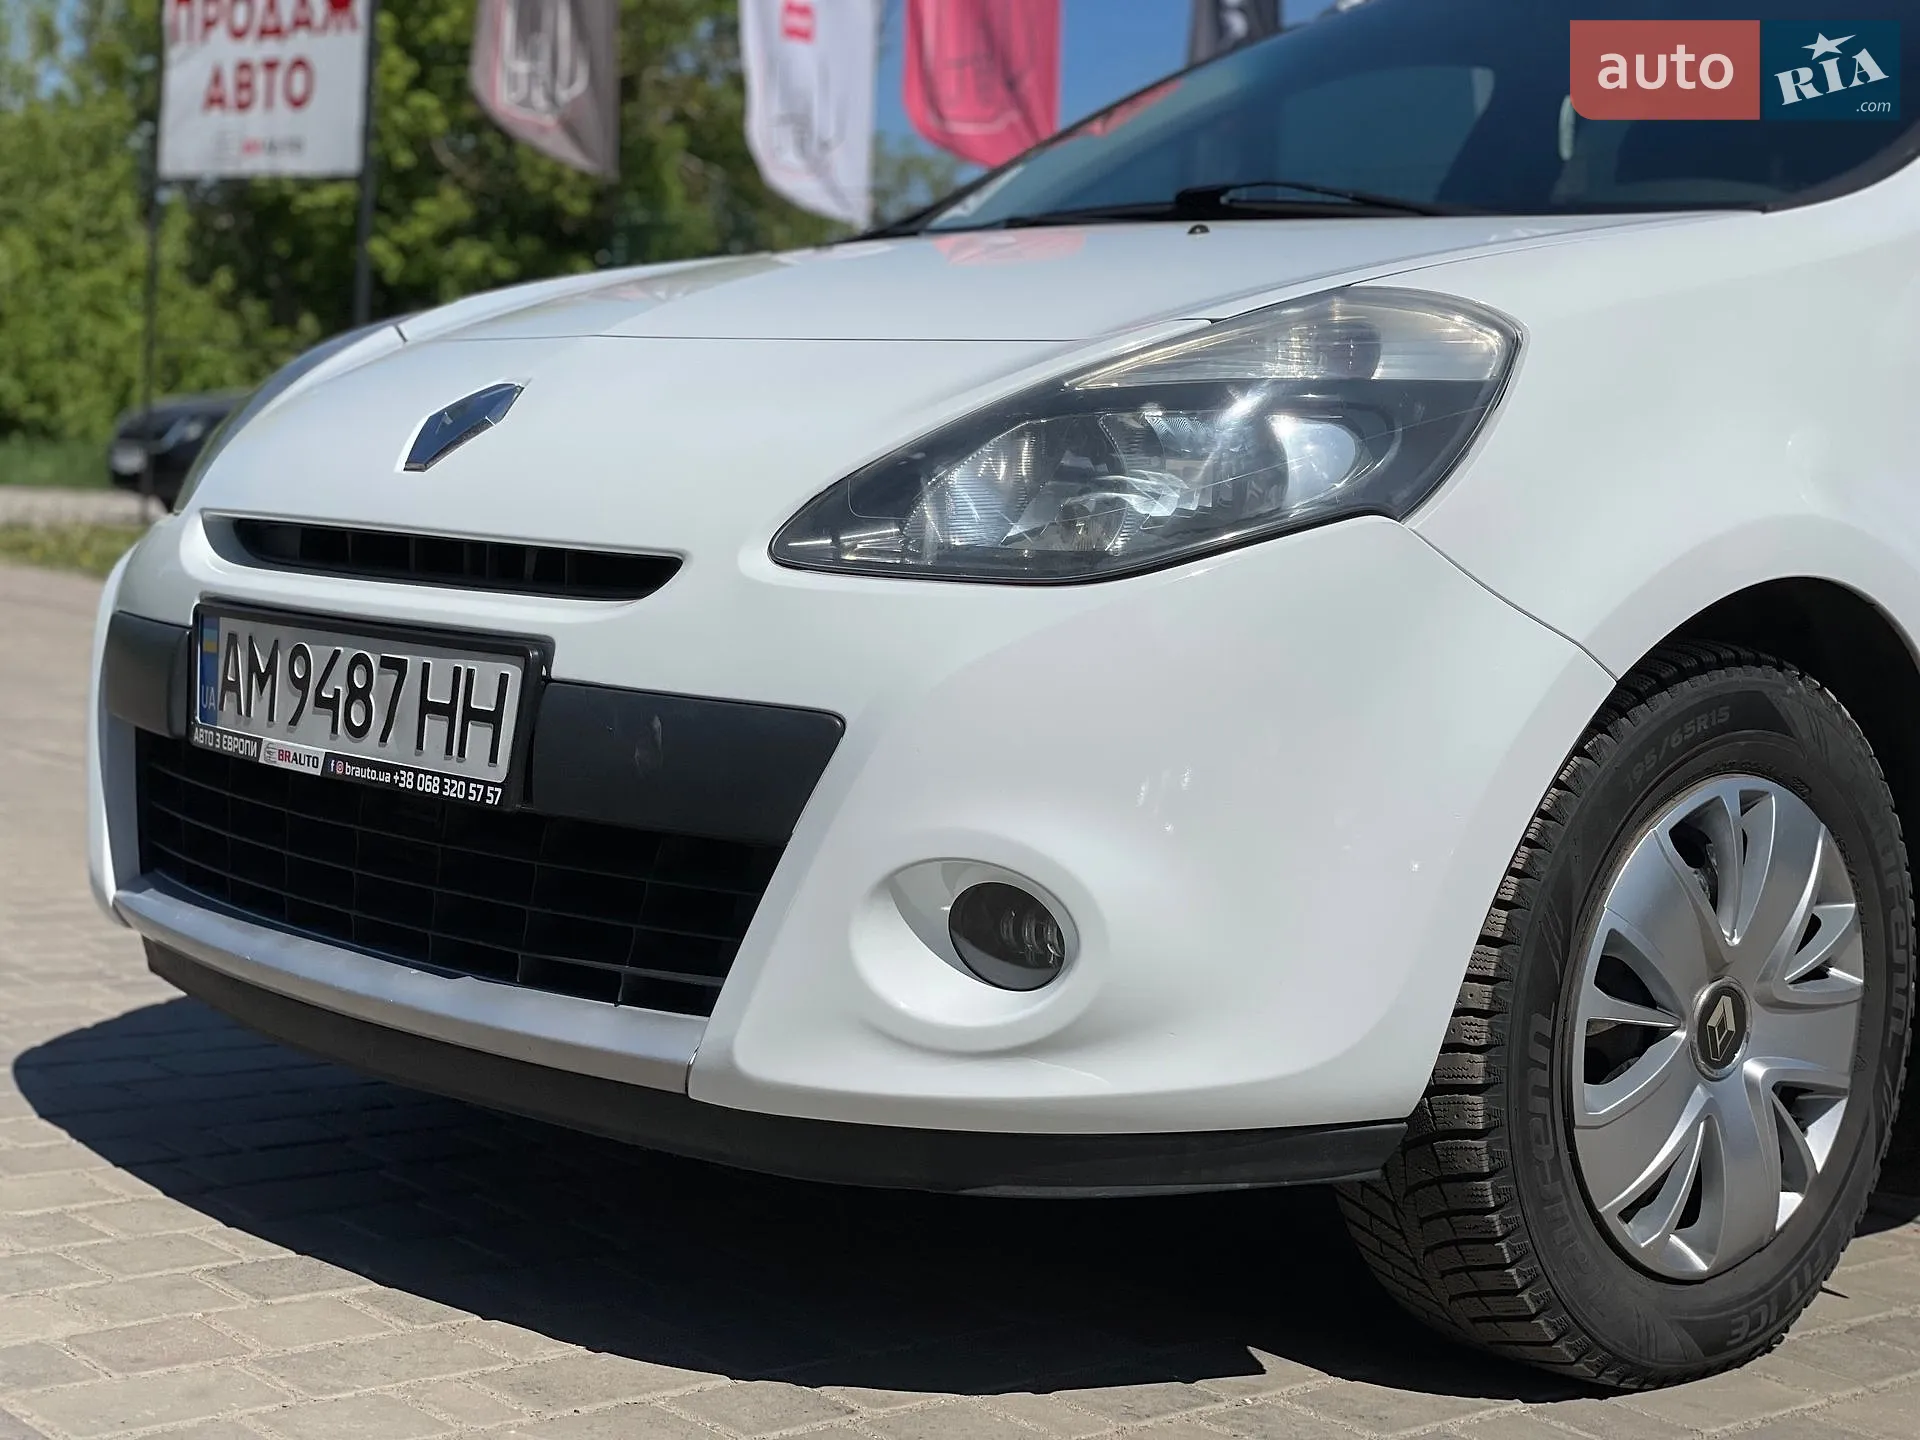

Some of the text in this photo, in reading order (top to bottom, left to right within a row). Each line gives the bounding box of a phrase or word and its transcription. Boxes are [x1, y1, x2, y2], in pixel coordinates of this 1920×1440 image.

[202, 57, 316, 112] АВТО
[201, 684, 216, 711] UA
[193, 727, 214, 746] АВТО
[277, 749, 320, 769] BRAUTO
[345, 762, 502, 805] brauto.ua +38 068 320 57 57
